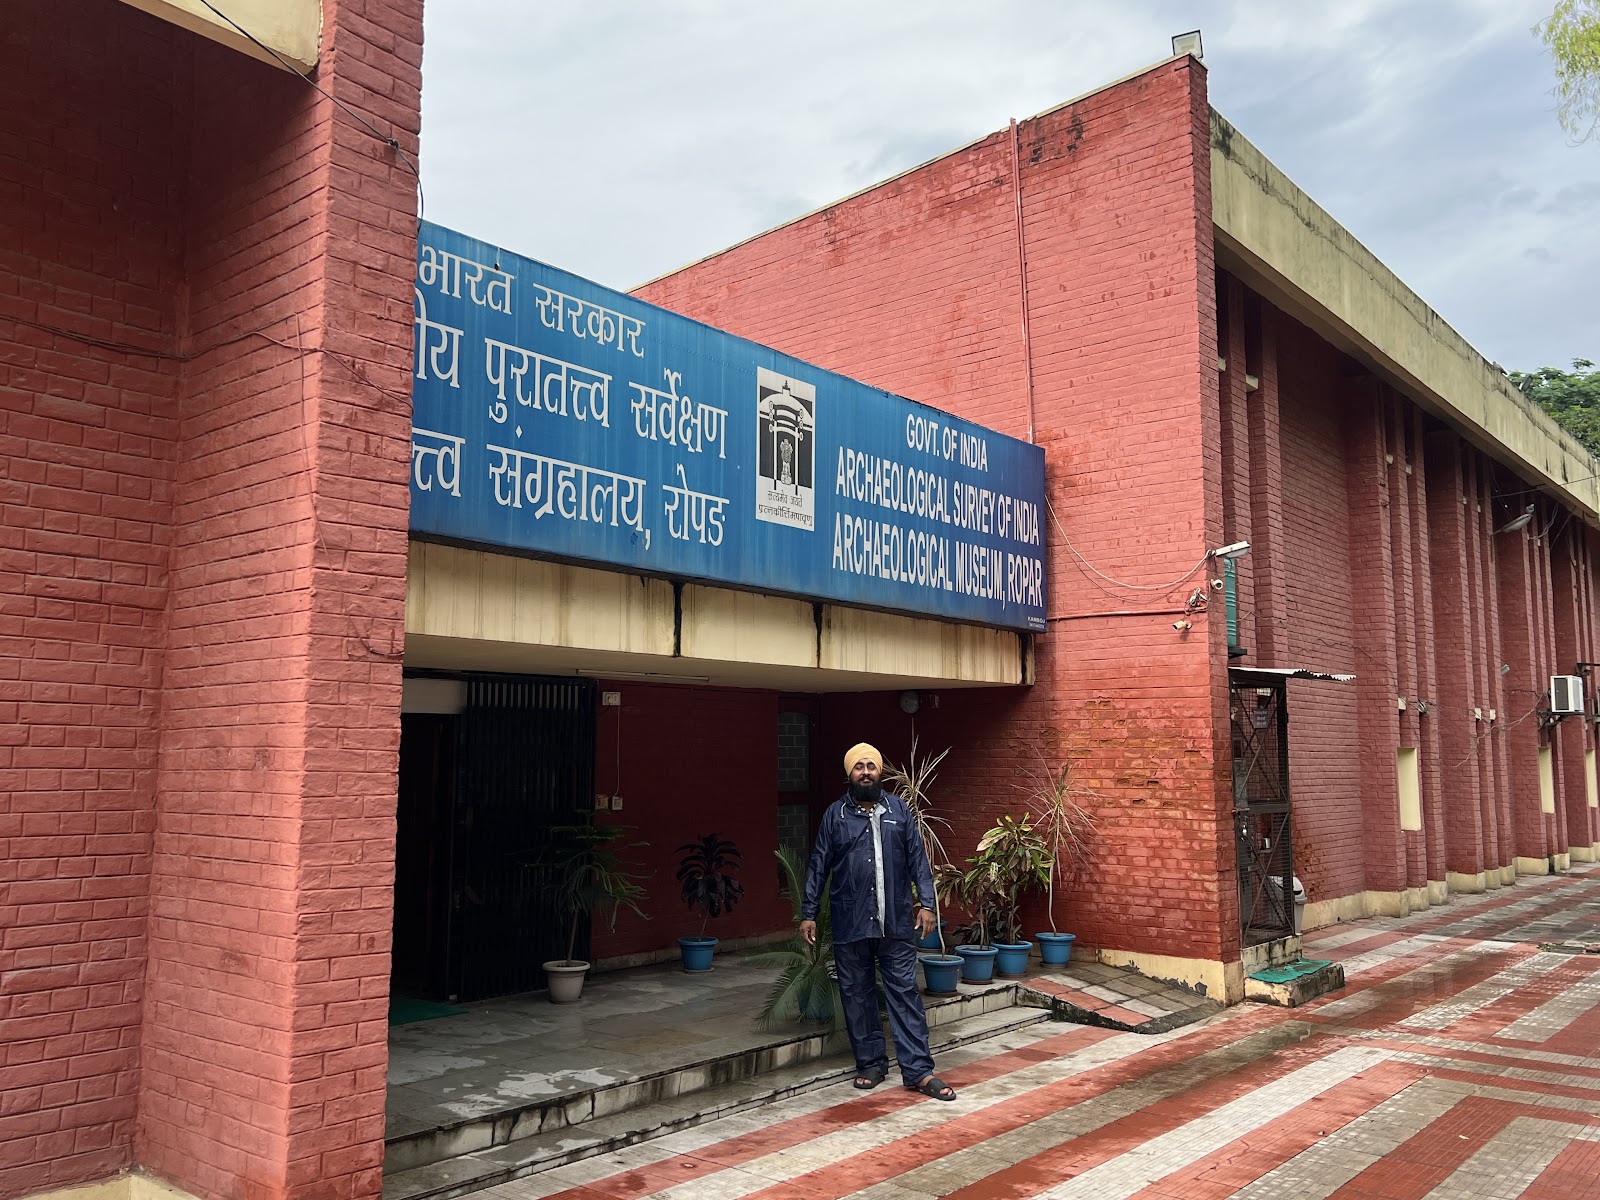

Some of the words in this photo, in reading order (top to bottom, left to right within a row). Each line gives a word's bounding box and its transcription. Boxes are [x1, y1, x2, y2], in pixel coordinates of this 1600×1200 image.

[418, 244, 517, 315] भारत
[533, 283, 647, 358] सरकार
[628, 367, 729, 459] सर्वेक्षण
[906, 413, 940, 457] GOVT.
[942, 426, 957, 462] OF
[960, 434, 988, 472] INDIA
[486, 425, 651, 551] संग्रहालय,
[835, 446, 951, 524] ARCHAEOLOGICAL
[953, 480, 996, 535] SURVEY
[997, 493, 1012, 538] OF
[1013, 498, 1040, 546] INDIA
[832, 512, 953, 592] ARCHAEOLOGICAL
[955, 541, 1006, 611] MUSEUM,
[1007, 553, 1043, 608] ROPAR
